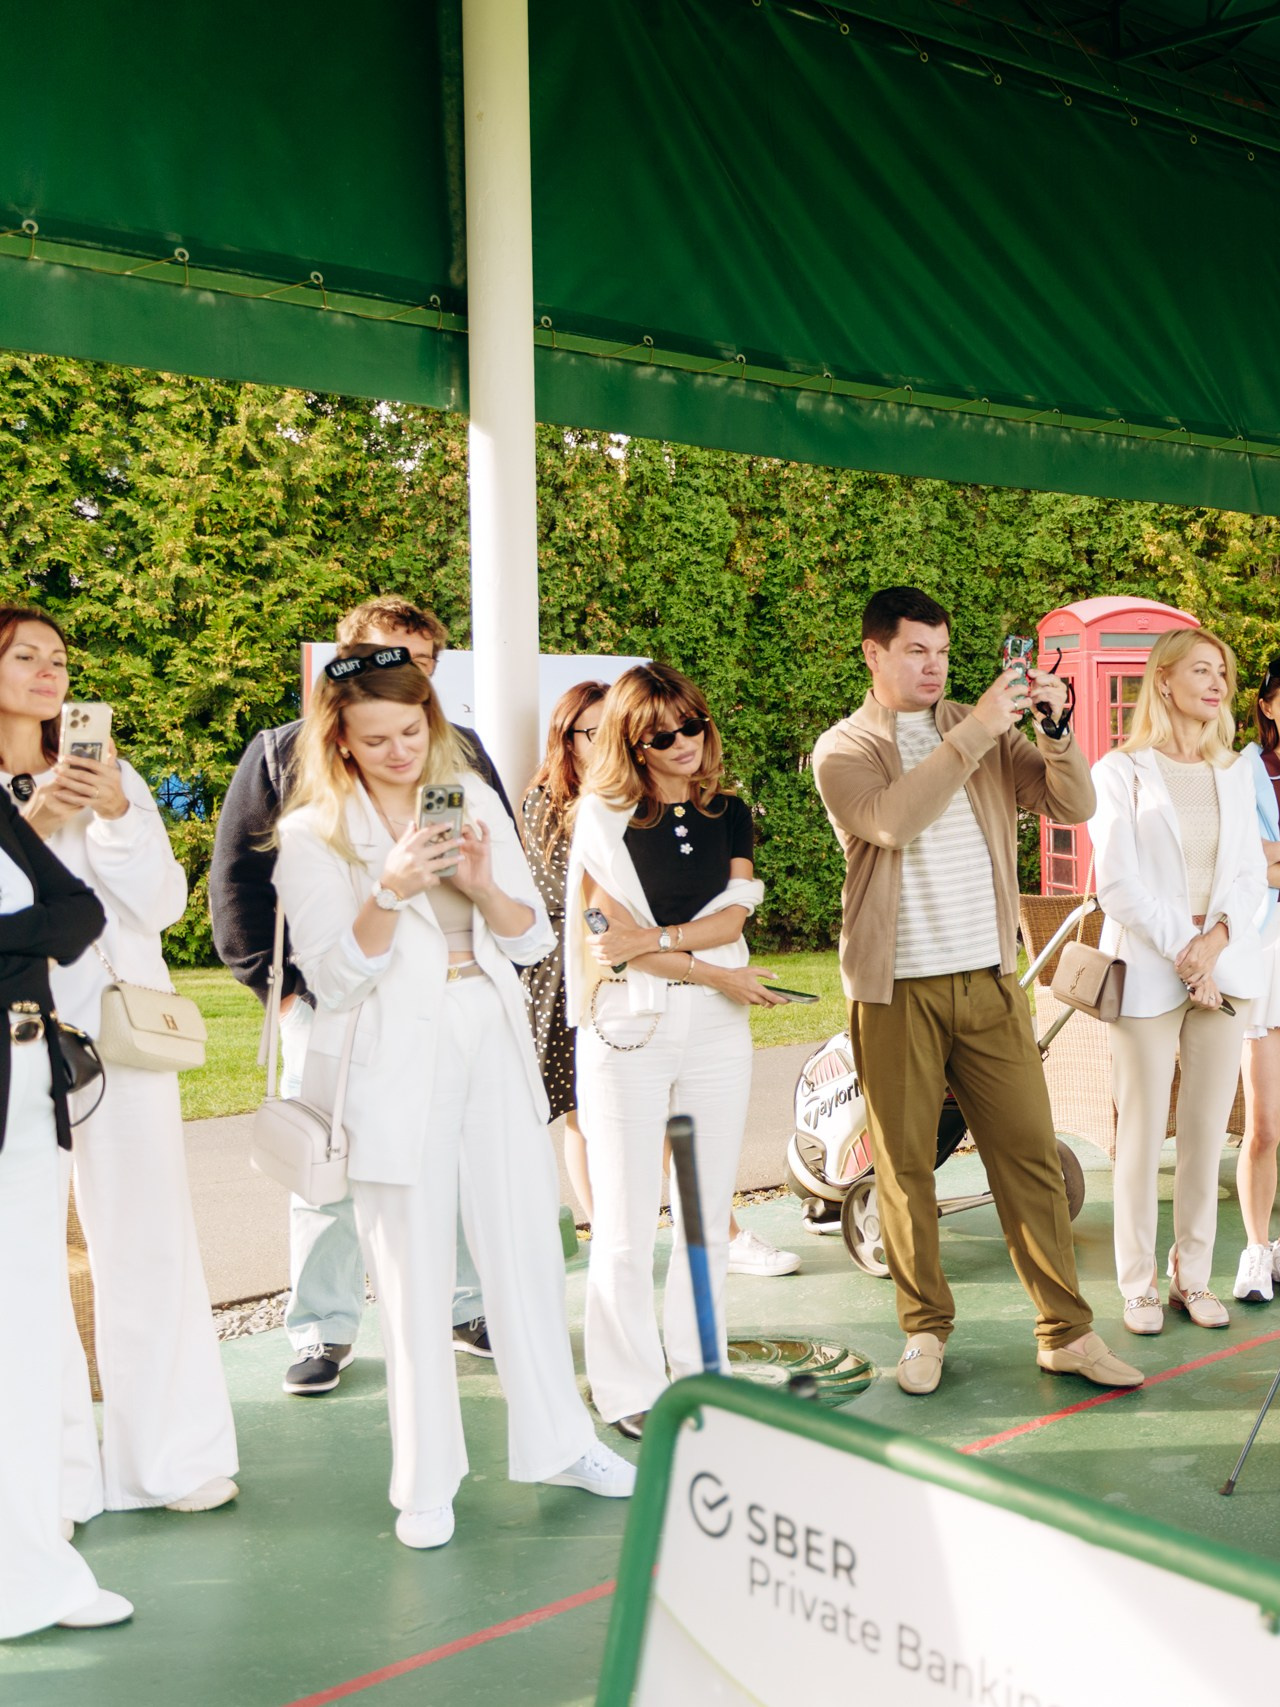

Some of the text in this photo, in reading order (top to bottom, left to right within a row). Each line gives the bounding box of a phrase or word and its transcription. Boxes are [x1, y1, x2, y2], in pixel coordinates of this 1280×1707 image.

[375, 649, 401, 665] GOLF
[746, 1503, 858, 1587] SBER
[748, 1556, 1062, 1707] Private Banki
